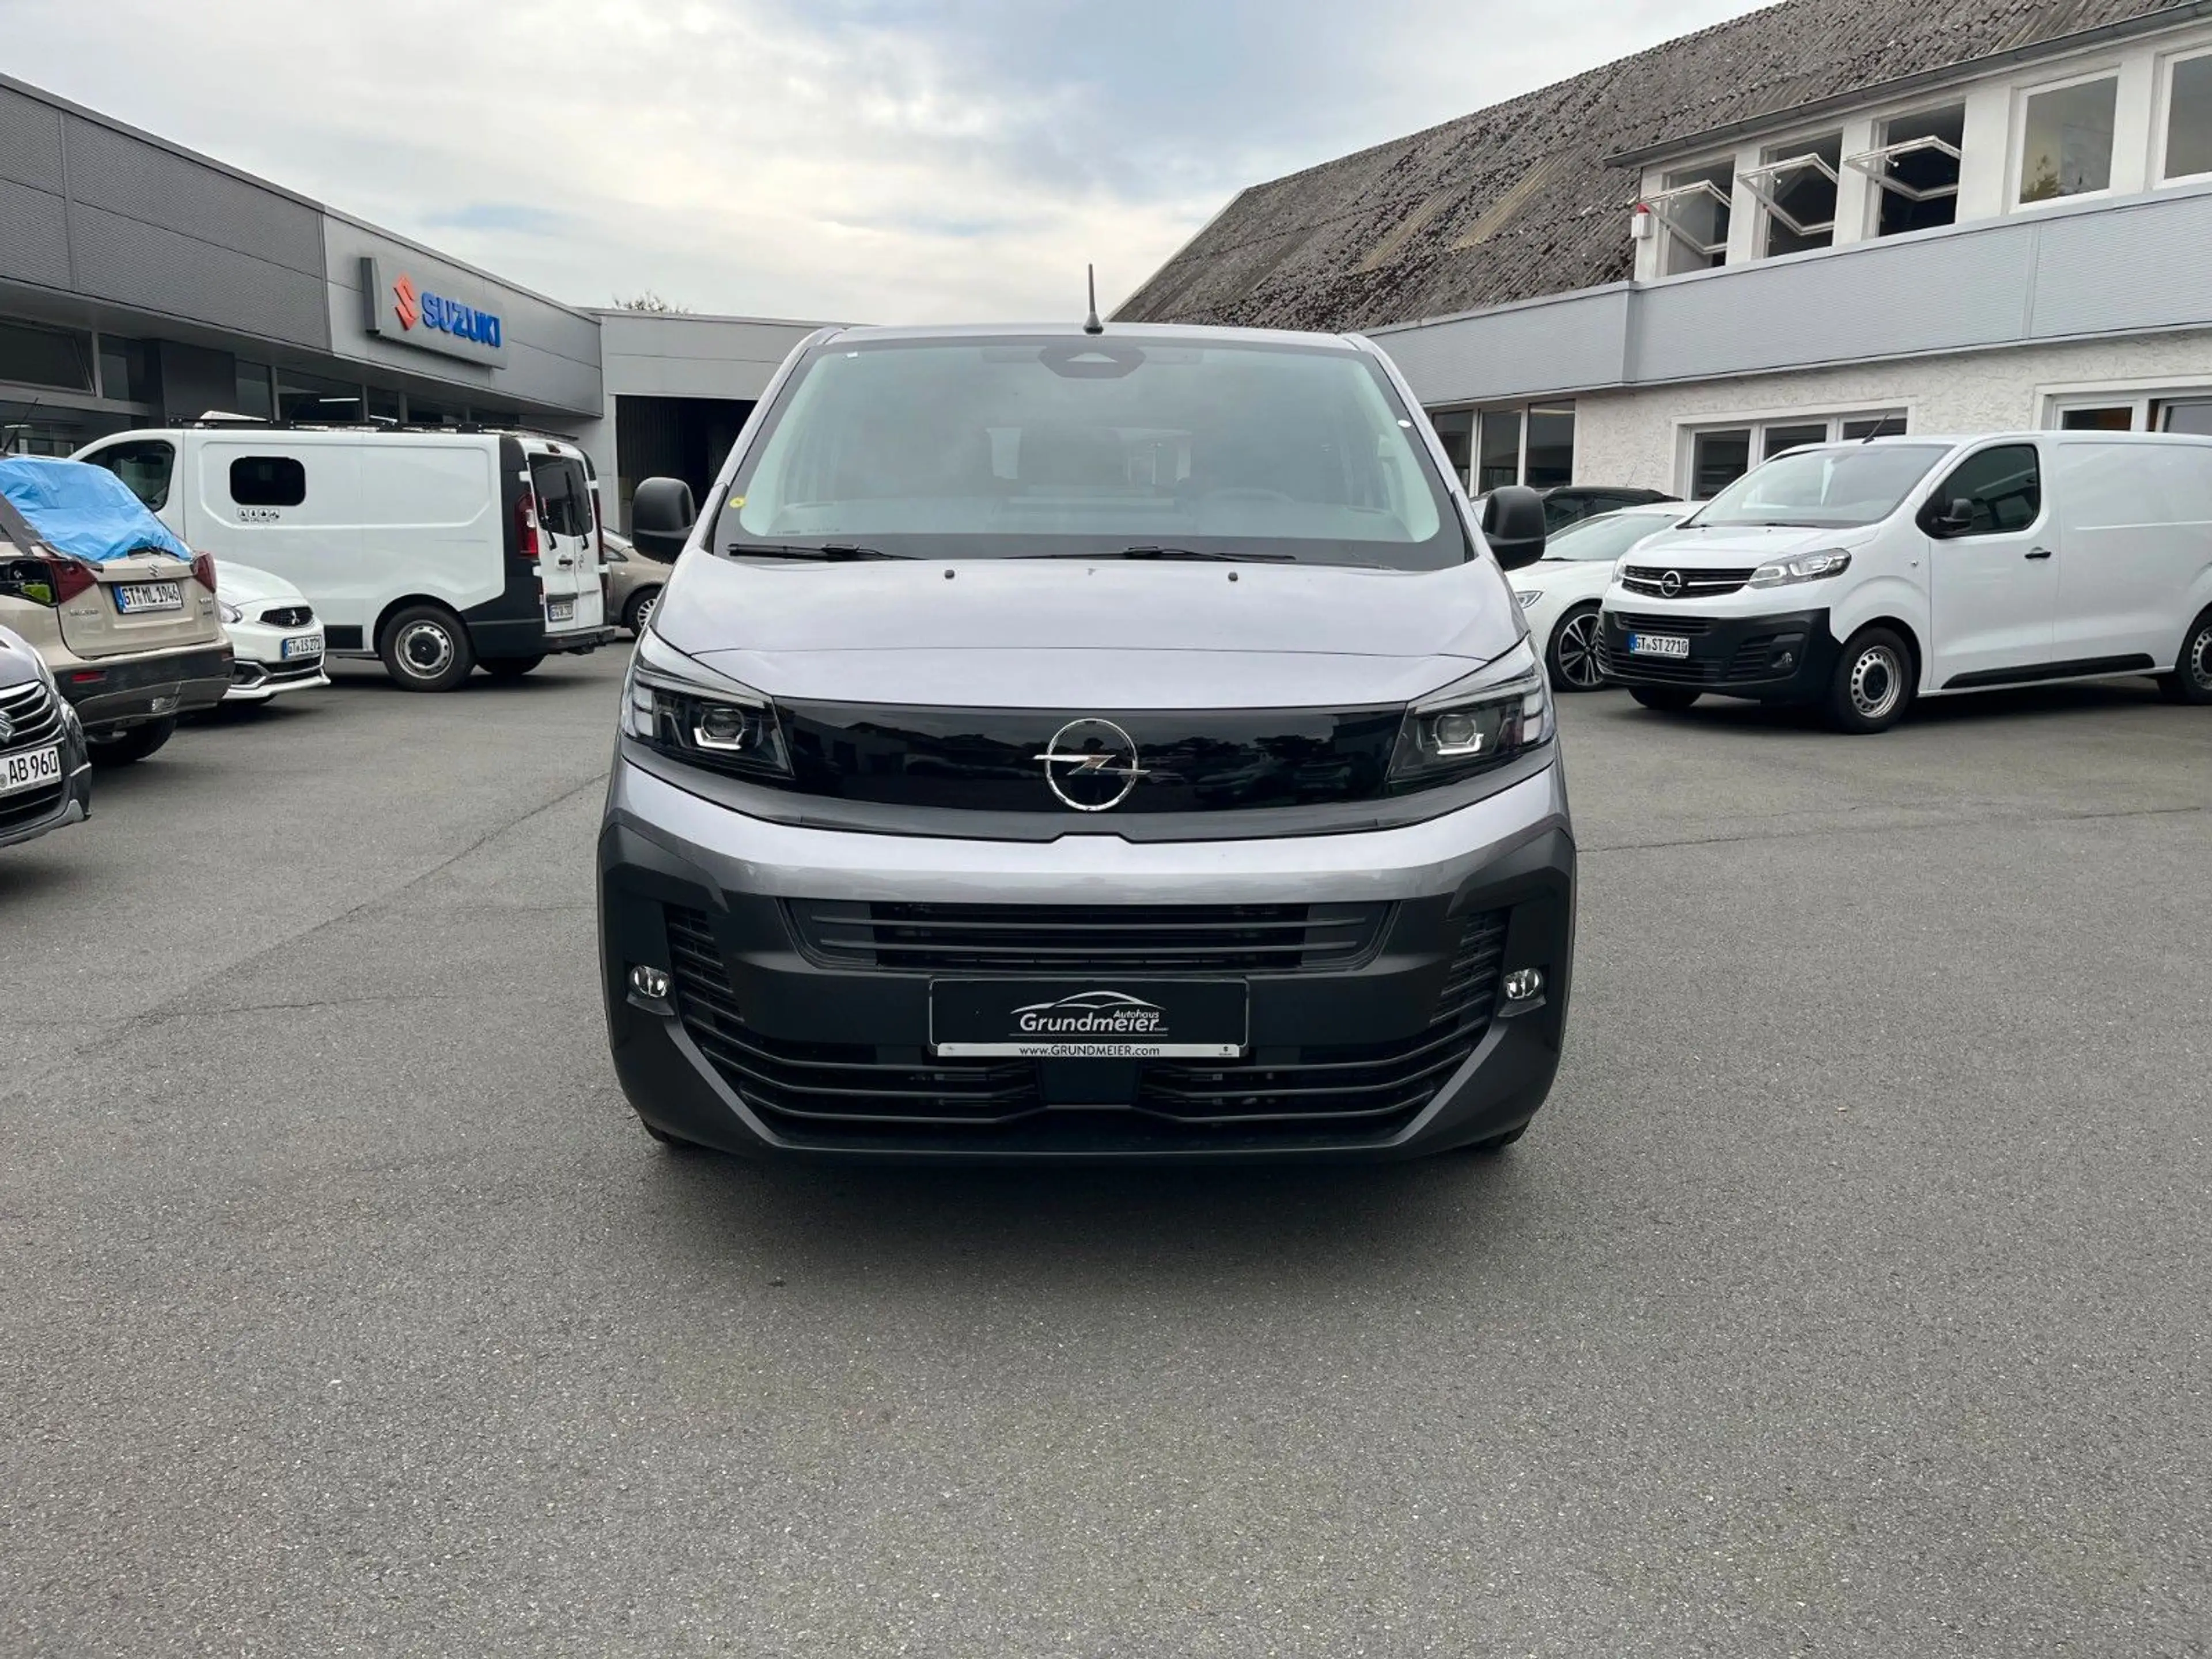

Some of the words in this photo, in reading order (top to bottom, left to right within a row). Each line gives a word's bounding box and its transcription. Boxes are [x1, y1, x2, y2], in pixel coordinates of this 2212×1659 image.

[422, 291, 501, 348] SUZUKI
[122, 587, 136, 605] GT
[1652, 638, 1663, 651] ST
[9, 757, 29, 784] AB
[30, 751, 58, 779] 960
[1020, 1012, 1160, 1032] Grundmeier
[1113, 1009, 1160, 1018] Autohaus
[1018, 1044, 1160, 1056] www.GRUNDMEIER.com
